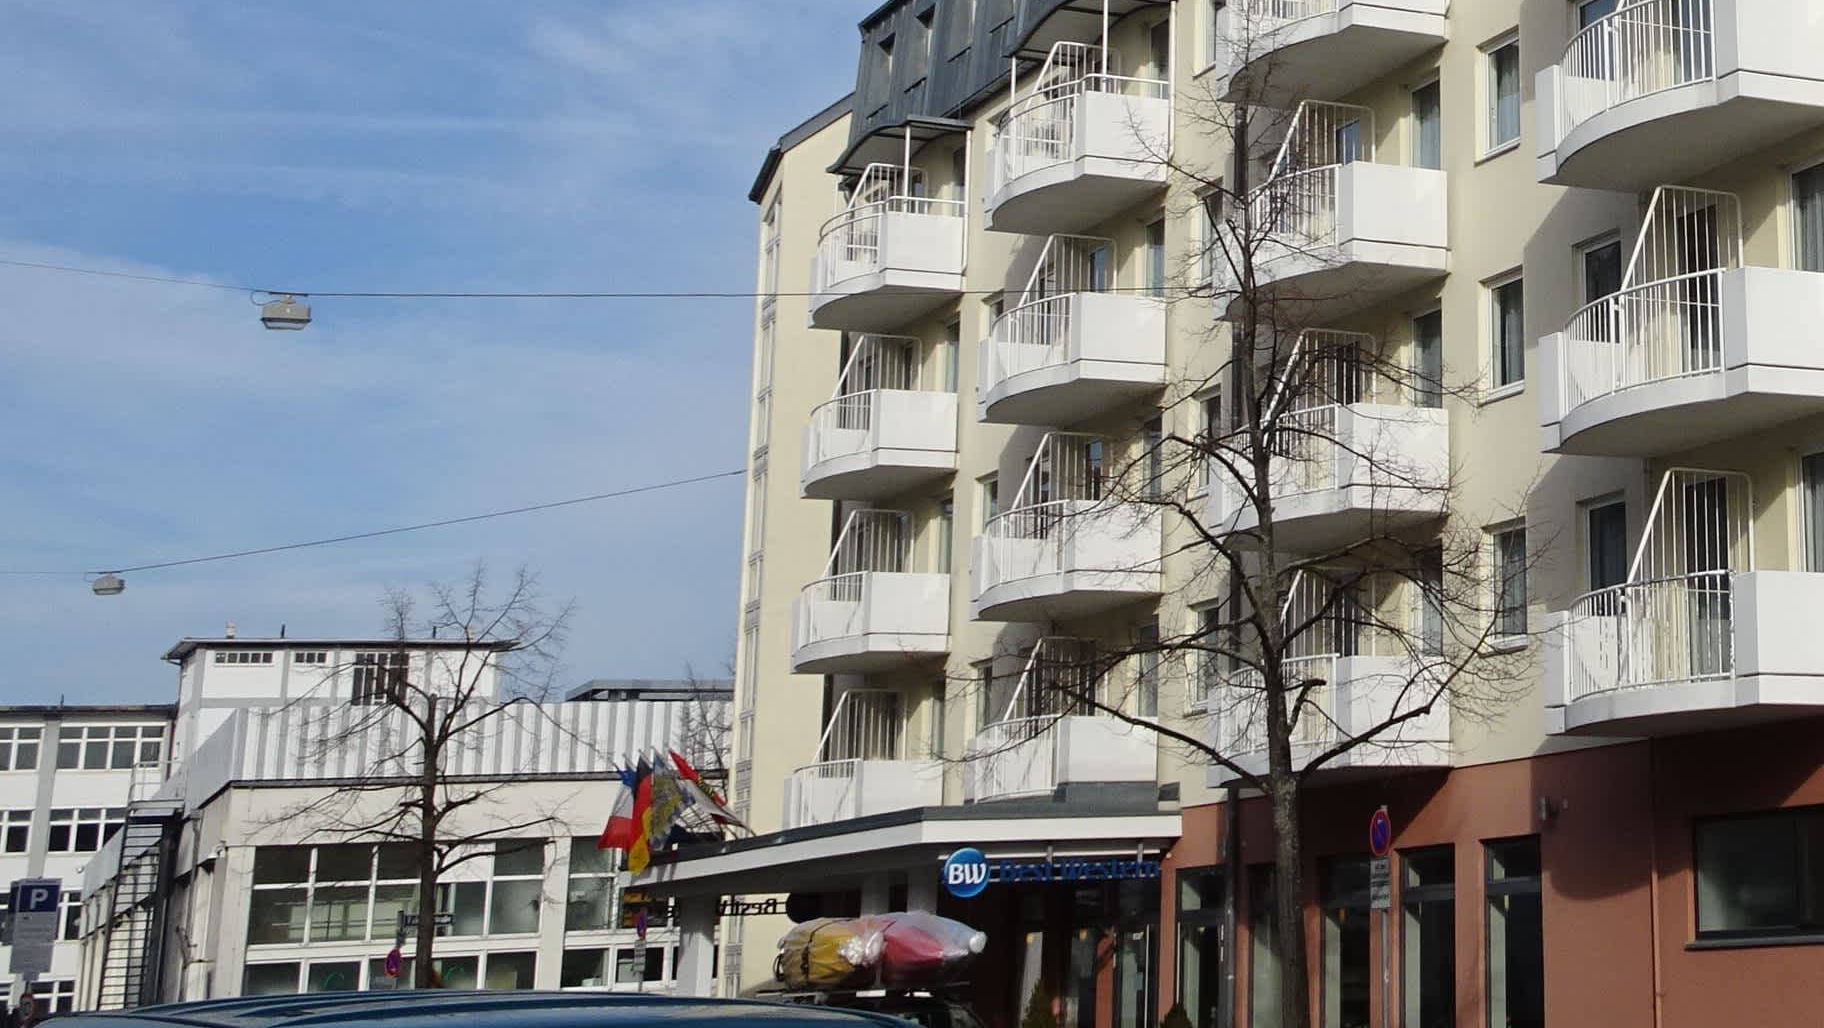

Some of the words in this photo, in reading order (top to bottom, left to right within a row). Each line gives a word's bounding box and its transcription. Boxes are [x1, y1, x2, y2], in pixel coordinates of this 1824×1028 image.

[949, 862, 987, 885] BW
[1000, 860, 1053, 883] Best
[1061, 858, 1160, 881] Western
